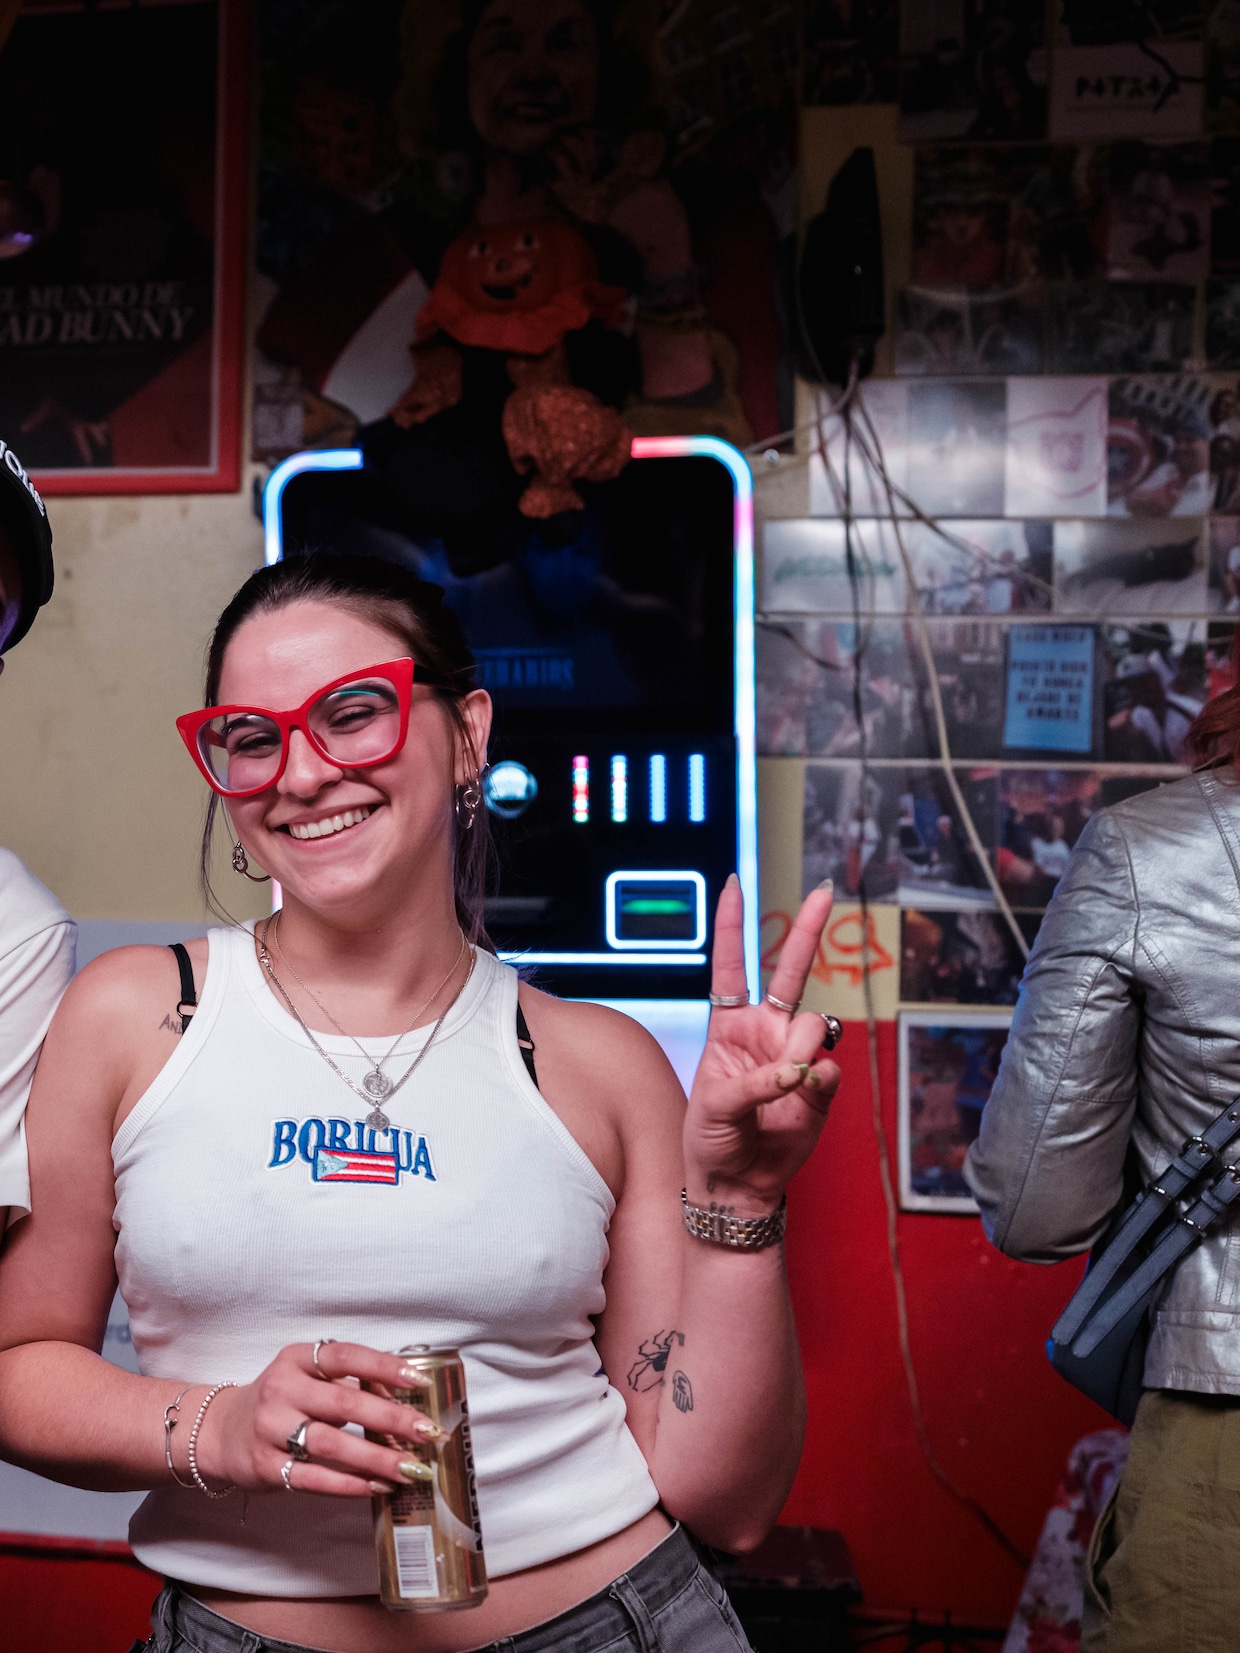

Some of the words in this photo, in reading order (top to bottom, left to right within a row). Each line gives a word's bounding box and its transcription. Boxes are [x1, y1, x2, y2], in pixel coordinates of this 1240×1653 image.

[25, 281, 139, 312] MUNDO
[141, 280, 184, 308] DE
[58, 305, 195, 344] BUNNY
